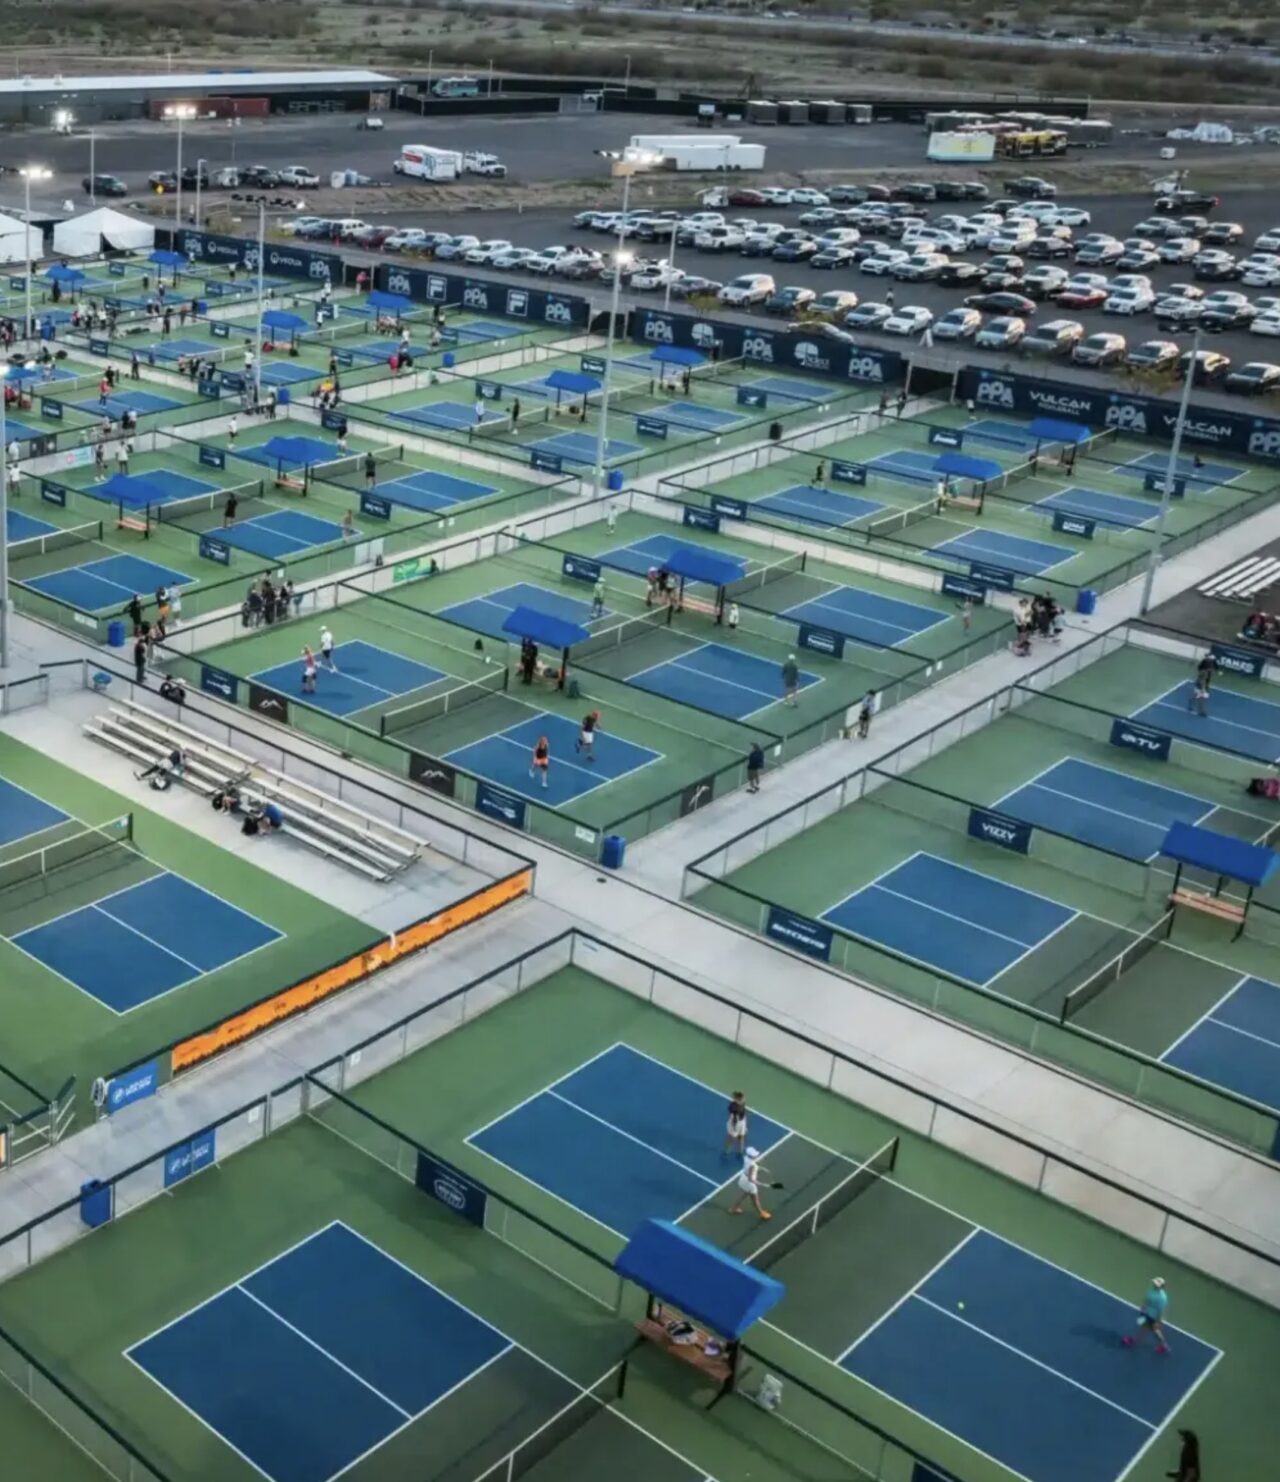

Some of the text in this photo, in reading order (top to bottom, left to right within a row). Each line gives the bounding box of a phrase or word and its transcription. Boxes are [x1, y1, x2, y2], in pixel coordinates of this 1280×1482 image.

[388, 275, 410, 292] PPA
[463, 287, 489, 306] PPA
[545, 303, 571, 322] PPA
[645, 320, 674, 341] PPA
[743, 338, 773, 359] PPA
[849, 357, 883, 379] PPA
[977, 381, 1014, 404] PPA
[1029, 391, 1091, 411] VULCAN
[1105, 405, 1148, 428] PPA
[982, 822, 1016, 841] VIZZY
